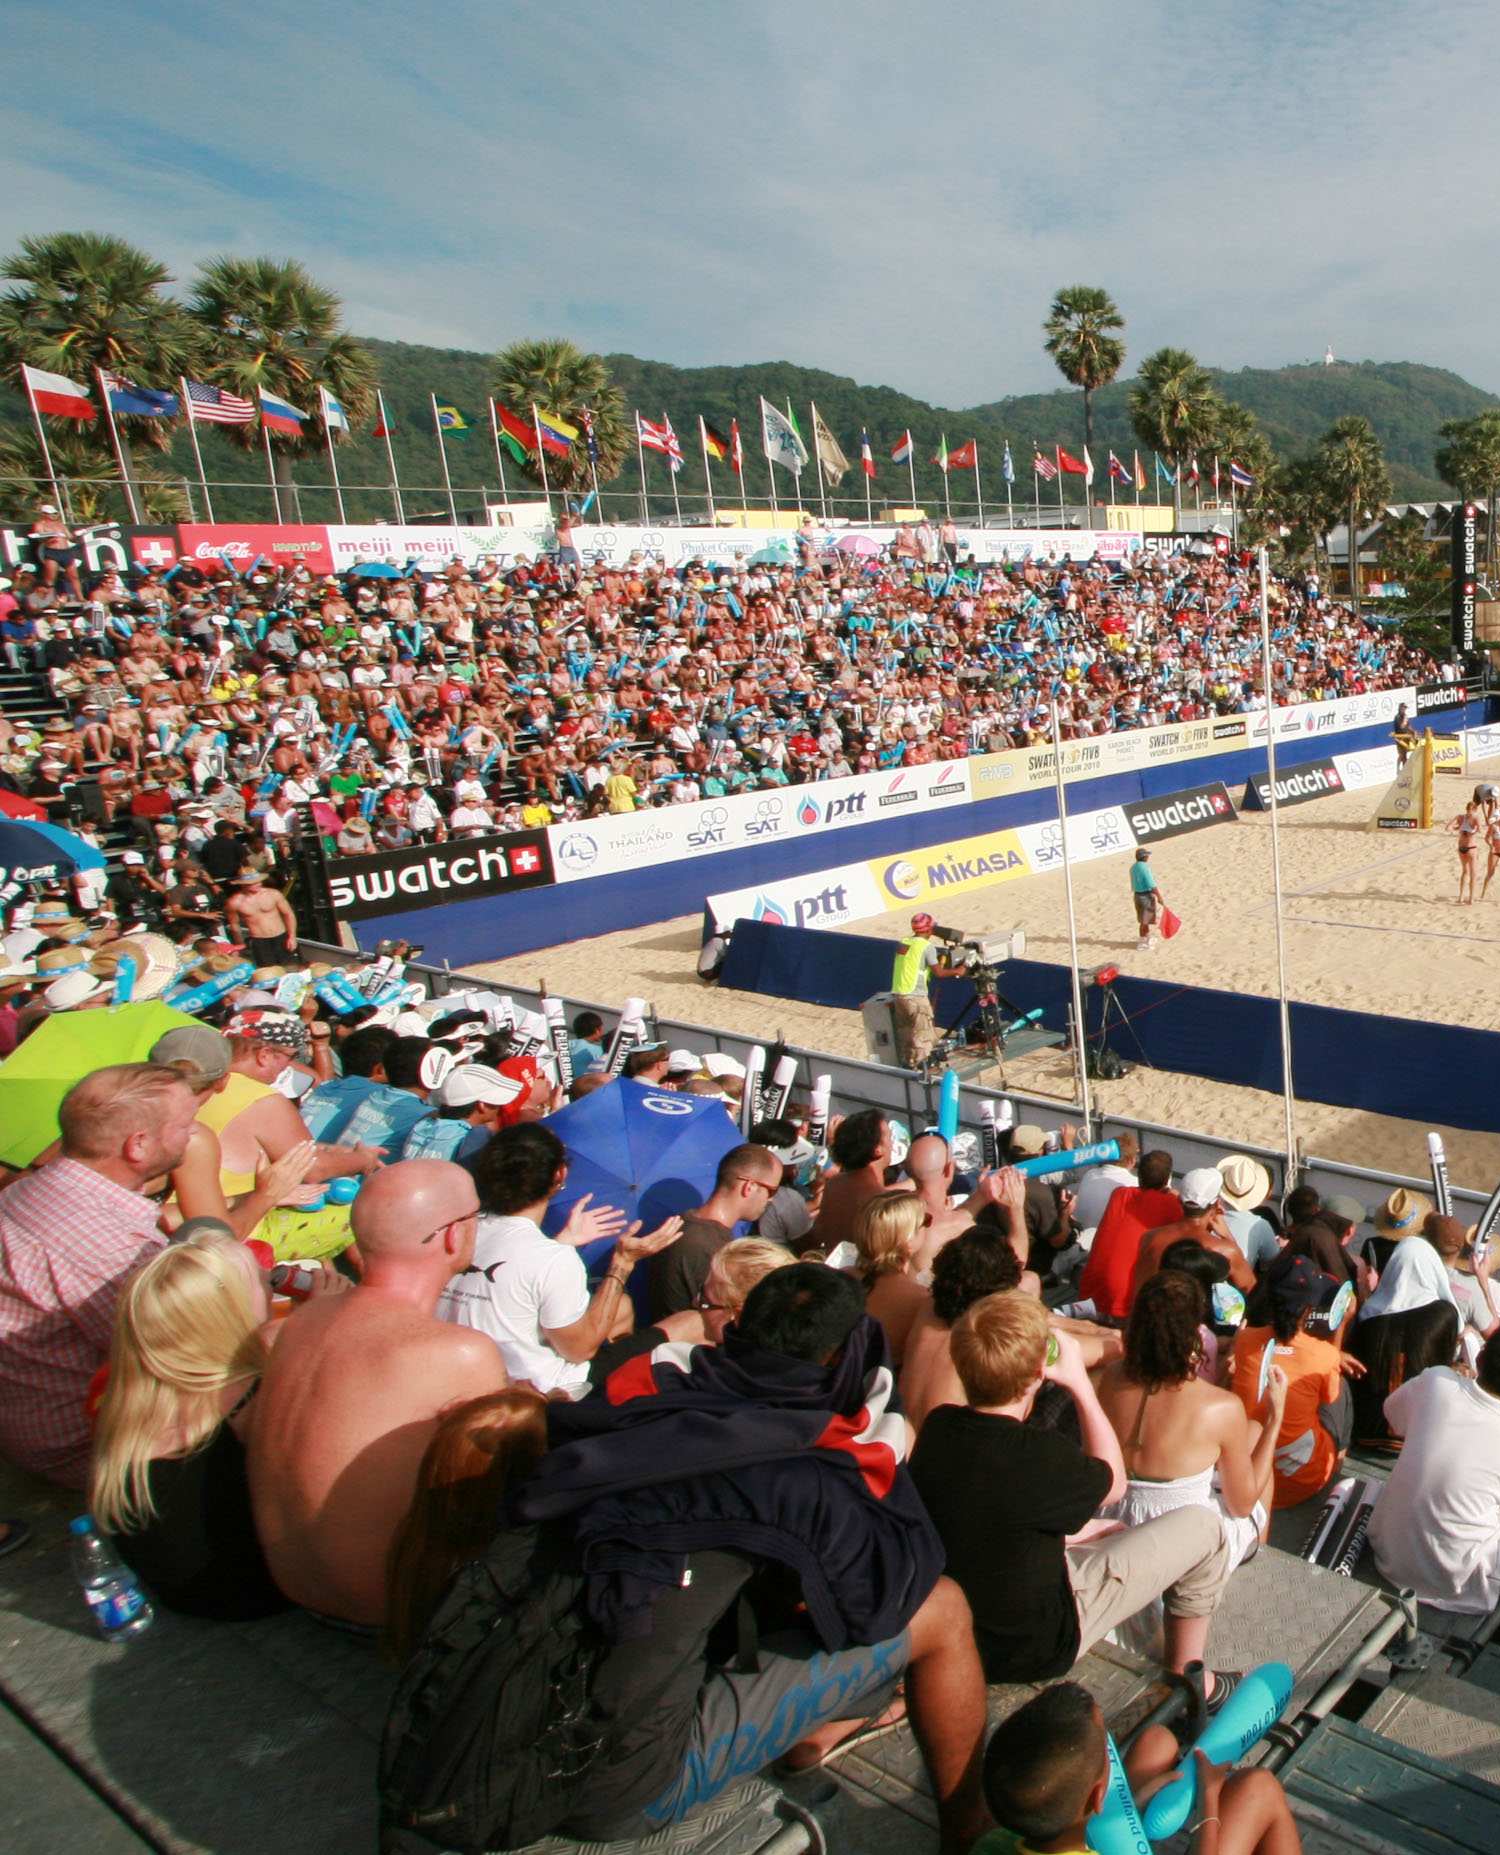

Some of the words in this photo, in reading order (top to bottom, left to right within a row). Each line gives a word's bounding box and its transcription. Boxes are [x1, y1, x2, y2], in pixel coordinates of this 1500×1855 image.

[196, 541, 253, 559] Coca-Cola
[338, 538, 392, 554] meiji
[405, 539, 455, 555] meiji
[582, 549, 615, 561] SAT
[681, 542, 716, 555] Phuket
[1464, 518, 1475, 574] swatch
[1462, 595, 1473, 650] swatch
[1418, 688, 1458, 709] swatch
[1317, 711, 1337, 730] ptt
[1150, 733, 1179, 749] SWATCH
[1193, 727, 1208, 740] FIVB
[1081, 745, 1100, 759] FIVB
[1150, 748, 1174, 758] WORLD
[1259, 769, 1328, 803] swatch
[825, 790, 866, 823] ptt
[1133, 792, 1211, 835] swatch
[609, 831, 673, 850] THAILAND
[687, 828, 726, 846] SAT
[745, 818, 781, 836] SAT
[1035, 843, 1064, 862] SAT
[1090, 831, 1121, 850] SAT
[329, 849, 508, 907] swatch
[793, 884, 848, 928] ptt
[816, 909, 850, 925] Group
[1240, 1720, 1263, 1749] TOUR
[1114, 1773, 1141, 1836] Thailand
